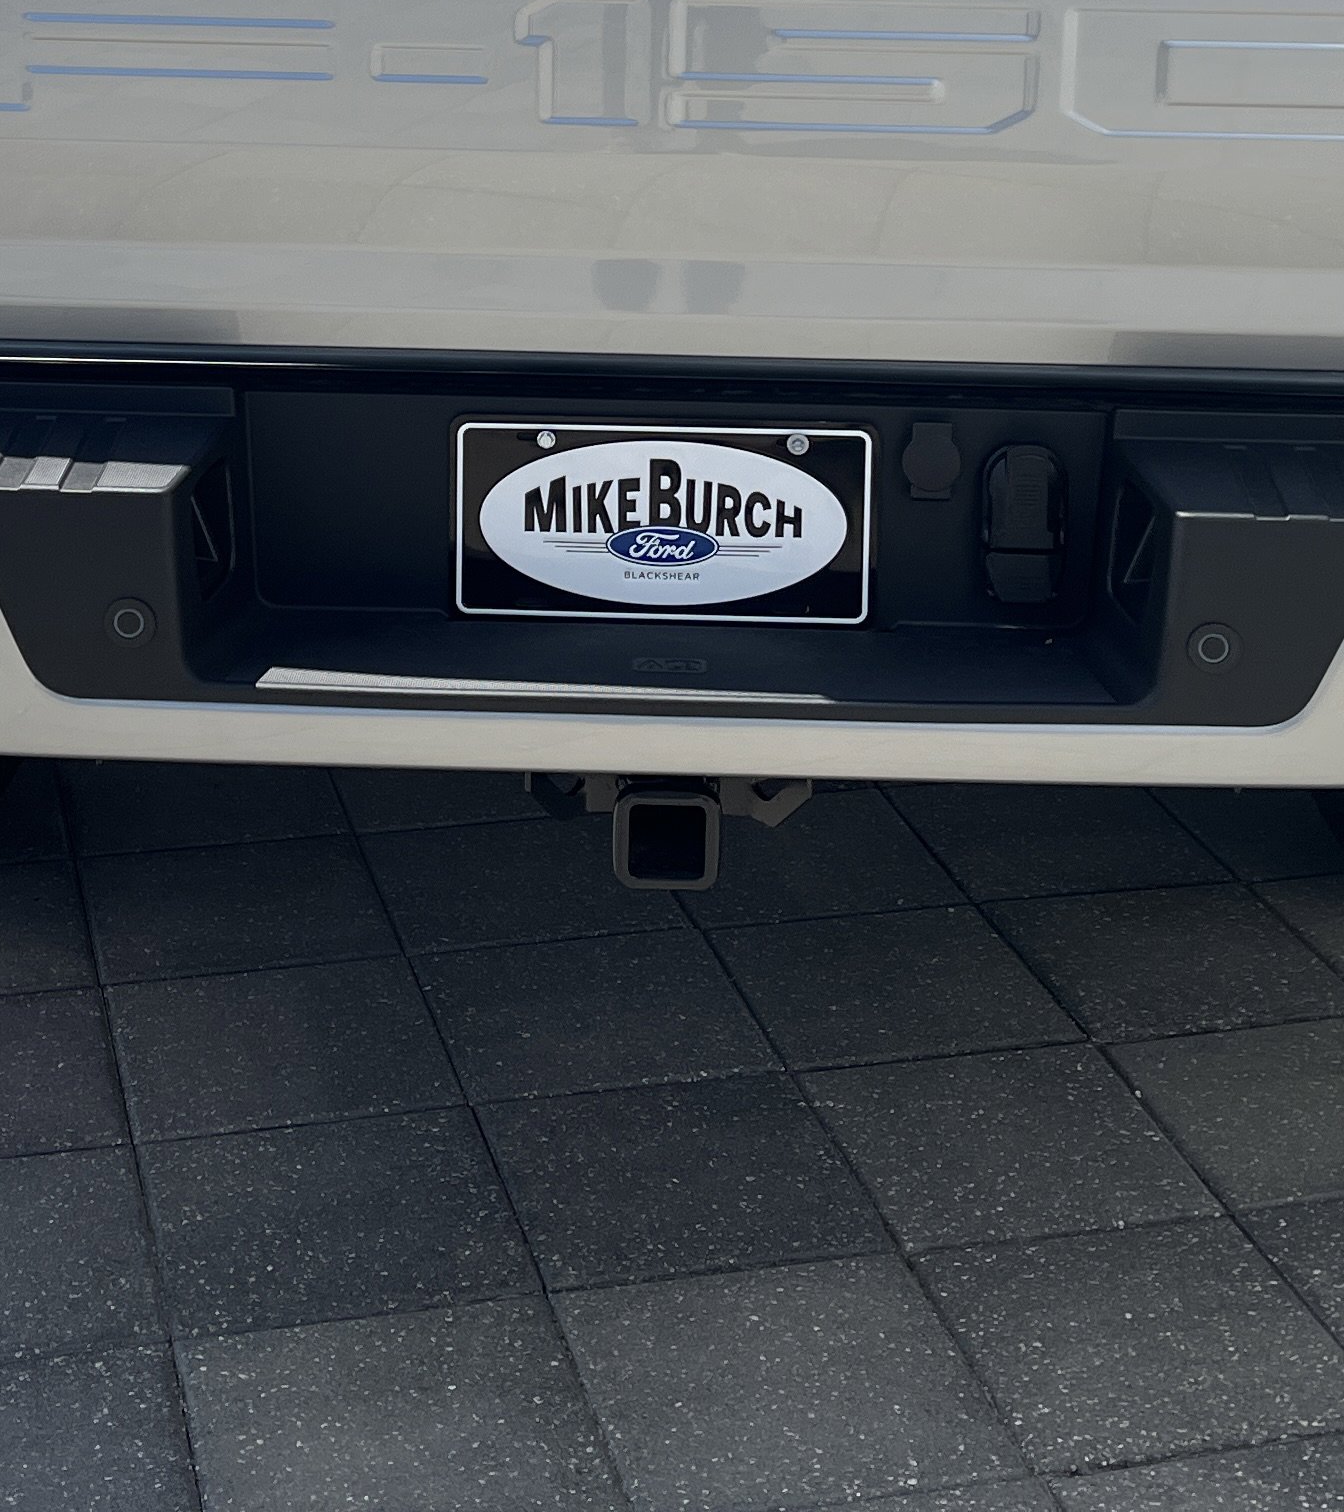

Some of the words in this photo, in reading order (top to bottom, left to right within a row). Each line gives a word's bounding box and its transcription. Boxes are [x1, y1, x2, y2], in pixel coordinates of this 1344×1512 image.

[524, 475, 641, 534] MIKE
[648, 458, 803, 538] BURCH
[628, 532, 695, 561] Ford
[623, 570, 701, 581] BLACKSHEAR
